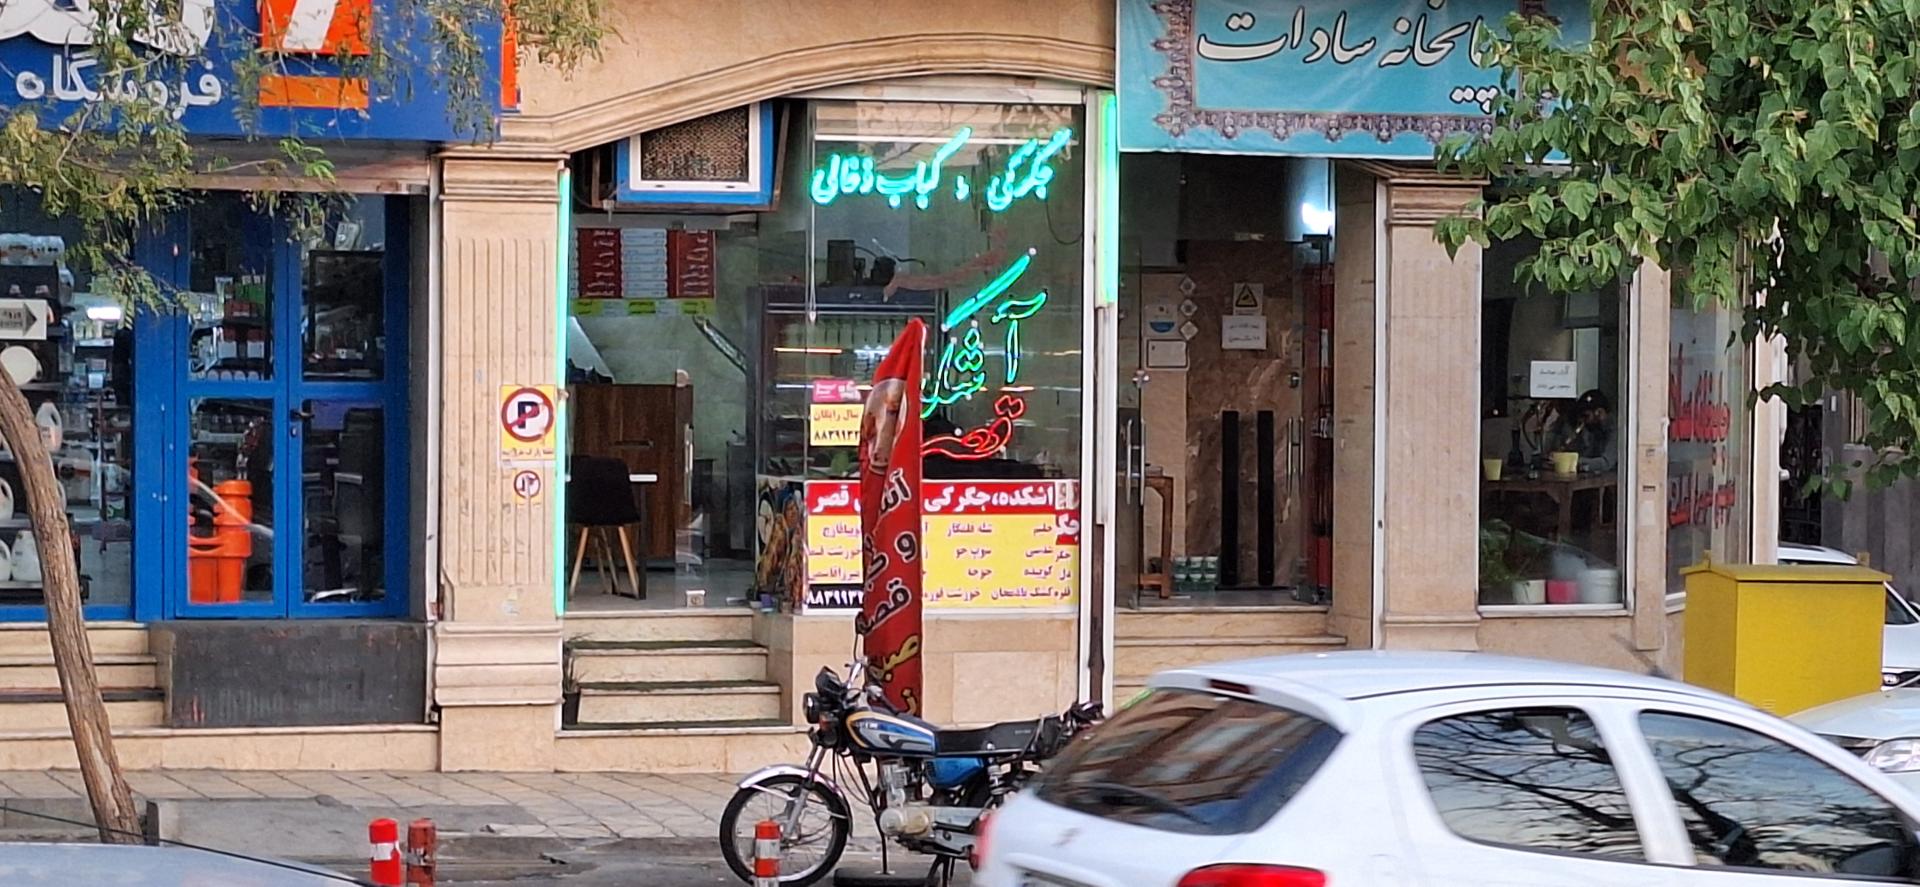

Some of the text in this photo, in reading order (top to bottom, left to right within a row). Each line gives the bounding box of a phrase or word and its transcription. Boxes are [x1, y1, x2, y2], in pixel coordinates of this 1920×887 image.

[1196, 7, 1376, 64] سادات
[876, 127, 972, 210] کباب
[812, 485, 850, 513] قصر
